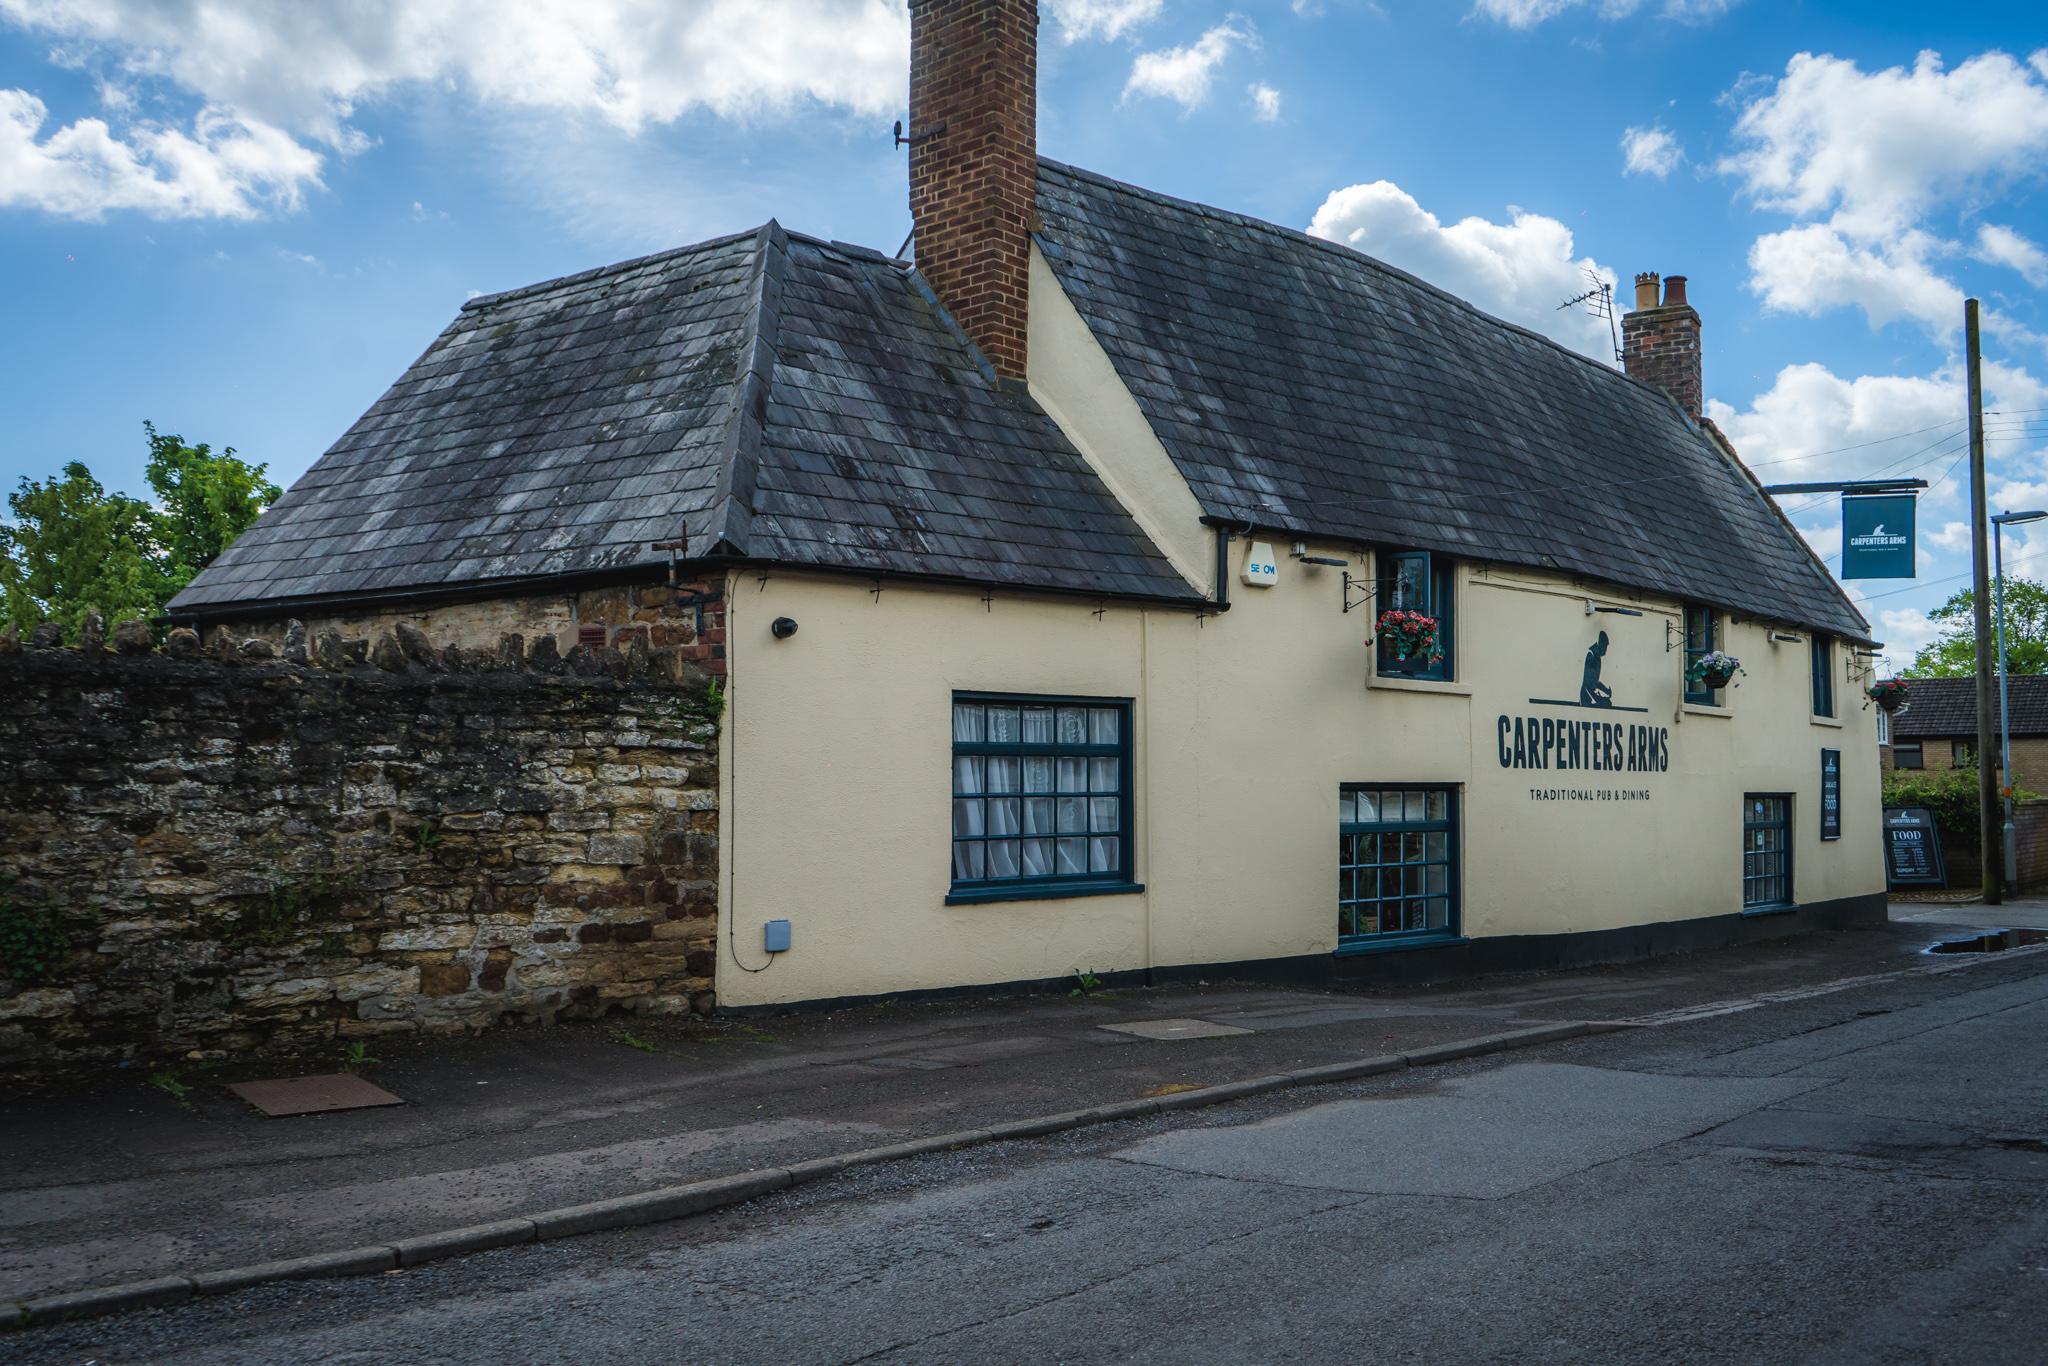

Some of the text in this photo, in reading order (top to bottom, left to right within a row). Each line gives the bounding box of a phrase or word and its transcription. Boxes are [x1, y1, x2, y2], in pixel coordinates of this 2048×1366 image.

[1851, 536, 1906, 546] CARPENTERS ARMS
[1498, 715, 1668, 772] CARPENTERS ARMS
[1530, 789, 1650, 801] TRADITIONAL PUB & DINING
[1892, 831, 1921, 840] FOOD
